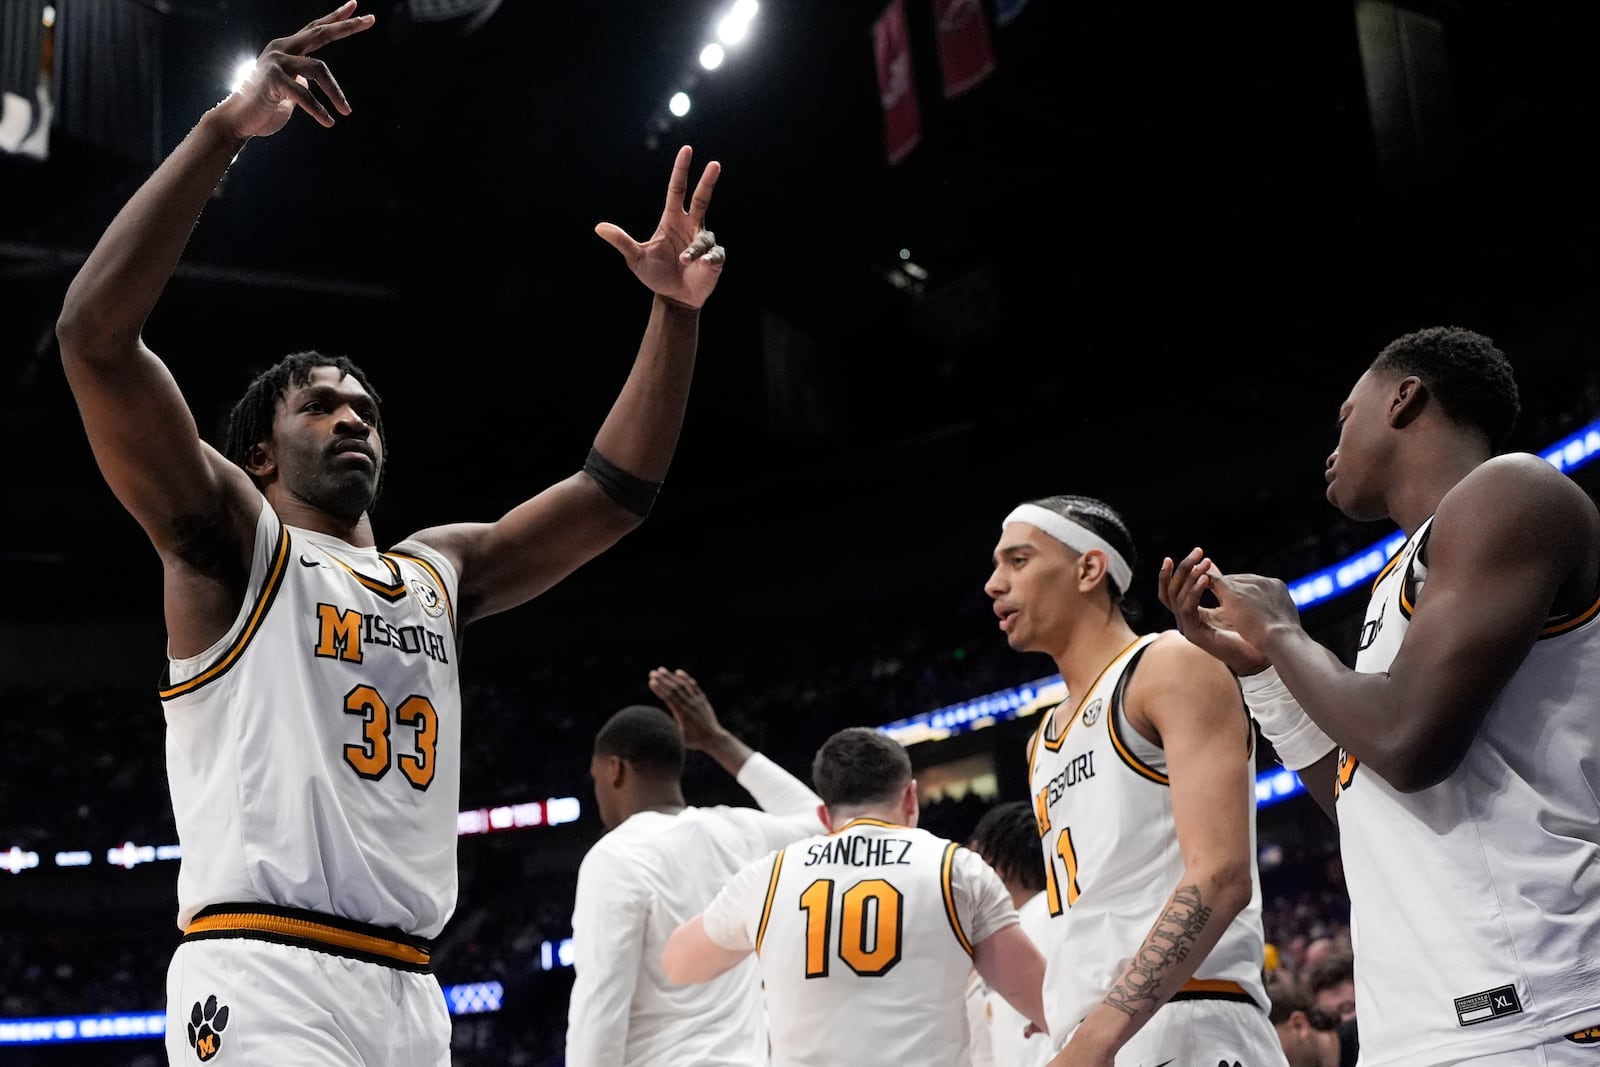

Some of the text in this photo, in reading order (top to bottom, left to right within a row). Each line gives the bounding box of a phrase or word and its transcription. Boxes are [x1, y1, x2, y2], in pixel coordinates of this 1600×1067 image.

[314, 602, 449, 665] MISSOURI
[343, 683, 439, 792] 33
[804, 834, 913, 867] SANCHEZ
[799, 878, 904, 979] 10
[1493, 995, 1513, 1009] XL
[197, 1033, 216, 1059] M
